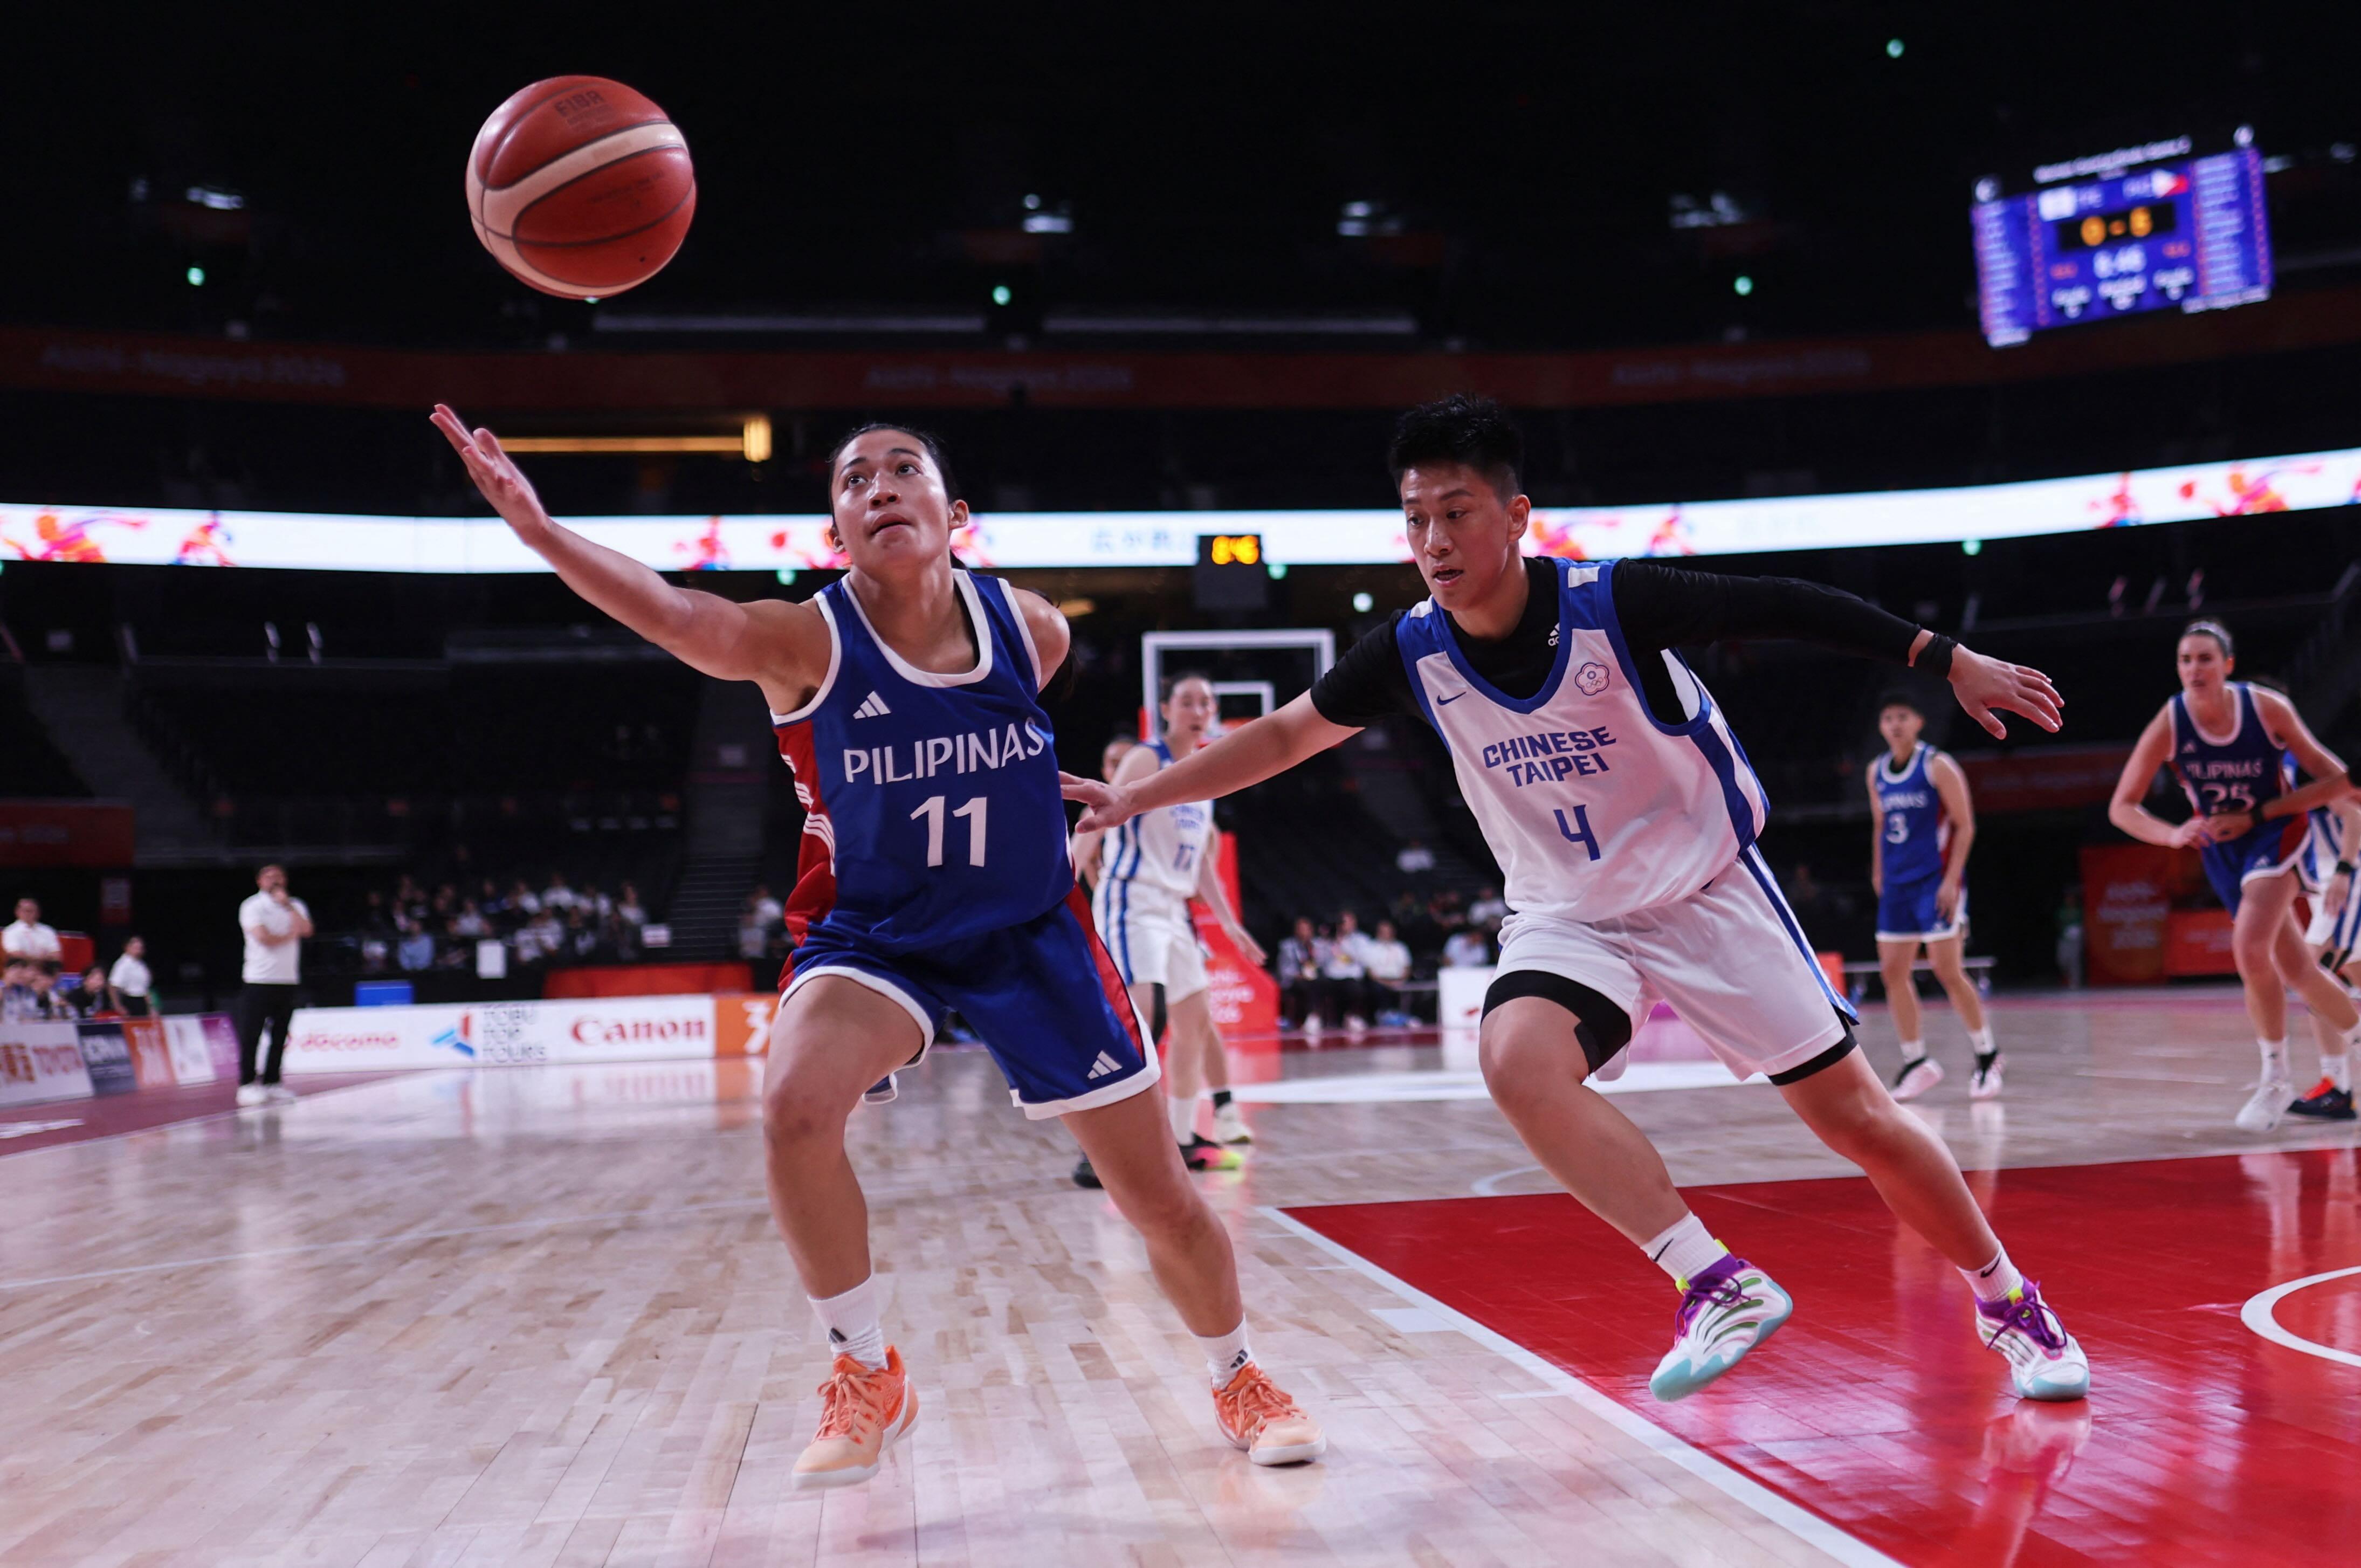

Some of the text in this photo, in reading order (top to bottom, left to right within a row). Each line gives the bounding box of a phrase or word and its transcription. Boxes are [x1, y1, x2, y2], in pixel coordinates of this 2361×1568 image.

[554, 91, 605, 117] FIBA
[844, 717, 1044, 785] PILIPINAS
[1483, 726, 1616, 768] CHINESE
[1507, 753, 1609, 788] TAIPEI
[910, 796, 987, 867] 11
[1553, 804, 1601, 861] 4
[1887, 813, 1909, 844] 3
[570, 1015, 706, 1046] Canon
